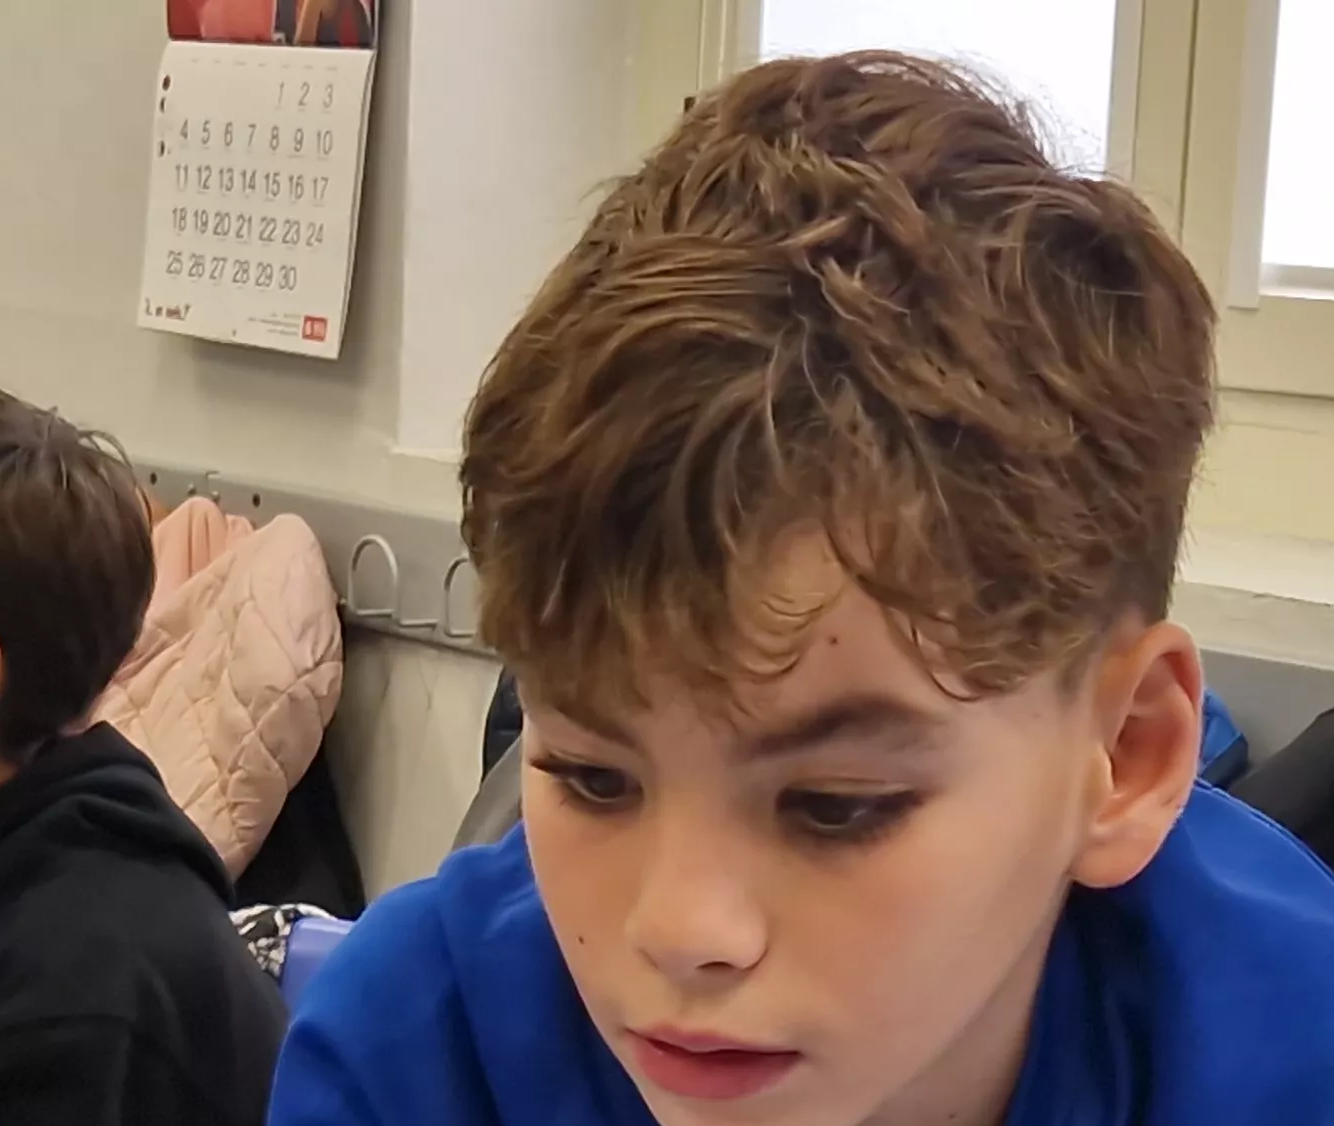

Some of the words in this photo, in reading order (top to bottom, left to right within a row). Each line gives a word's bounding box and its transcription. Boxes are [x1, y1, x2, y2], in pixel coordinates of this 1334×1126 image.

[277, 81, 285, 104] 1
[297, 80, 310, 107] 2
[322, 83, 334, 109] 3
[179, 118, 189, 140] 4
[201, 119, 210, 145] 5
[224, 122, 233, 147] 6
[247, 123, 257, 147] 7
[269, 124, 280, 151] 8
[293, 127, 304, 153] 9
[316, 128, 334, 157] 10
[174, 163, 190, 190] 11
[195, 164, 213, 191] 12
[218, 166, 235, 193] 13
[239, 168, 258, 193] 14
[263, 171, 282, 198] 15
[287, 173, 305, 201] 16
[312, 175, 330, 201] 17
[171, 206, 188, 233] 18
[192, 208, 210, 236] 19
[211, 209, 232, 237] 20
[234, 212, 254, 240] 21
[257, 215, 278, 243] 22
[280, 217, 302, 246] 23
[304, 220, 325, 248] 24
[165, 249, 185, 276] 25
[186, 251, 207, 279] 26
[208, 255, 229, 281] 27
[231, 258, 251, 285] 28
[254, 260, 275, 288] 29
[277, 263, 298, 292] 30
